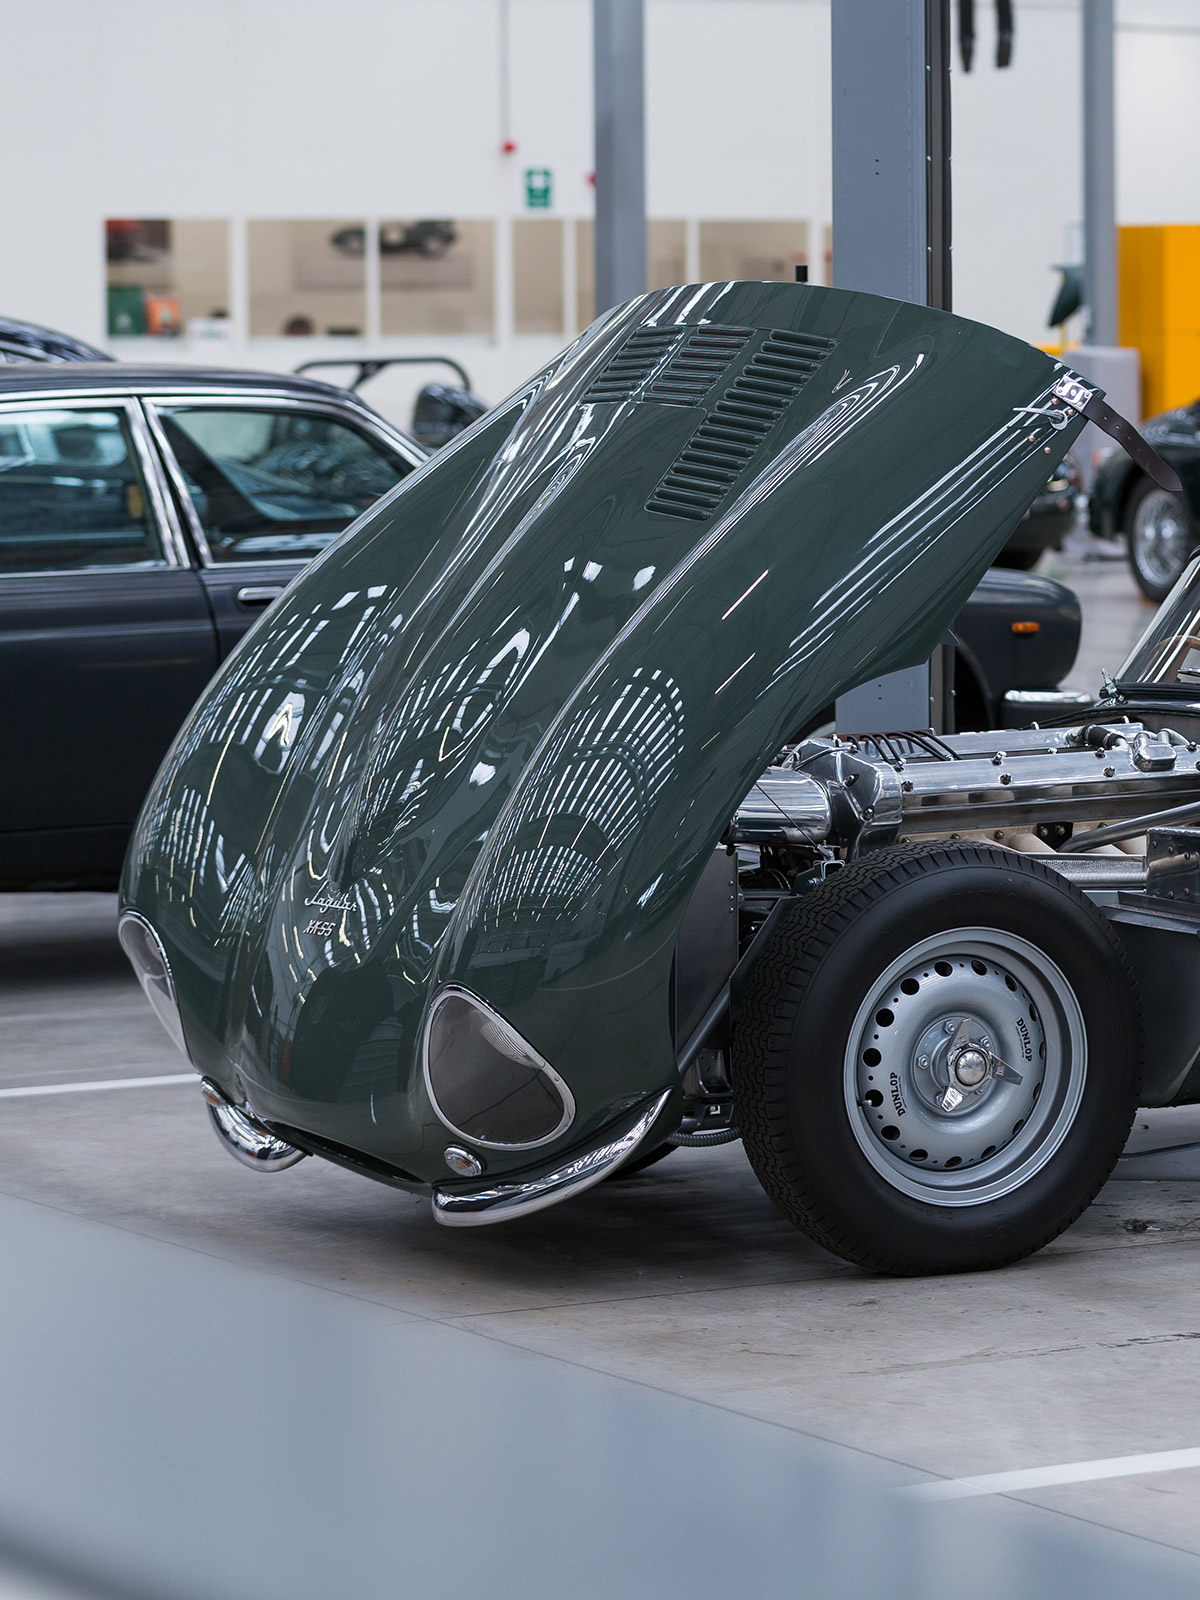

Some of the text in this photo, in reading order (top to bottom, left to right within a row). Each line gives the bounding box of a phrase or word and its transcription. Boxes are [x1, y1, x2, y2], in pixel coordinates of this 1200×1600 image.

[304, 879, 357, 913] Jaguar
[302, 919, 337, 937] XKSS
[1016, 1017, 1033, 1062] DUNLOP
[890, 1071, 906, 1117] DUNLOP
